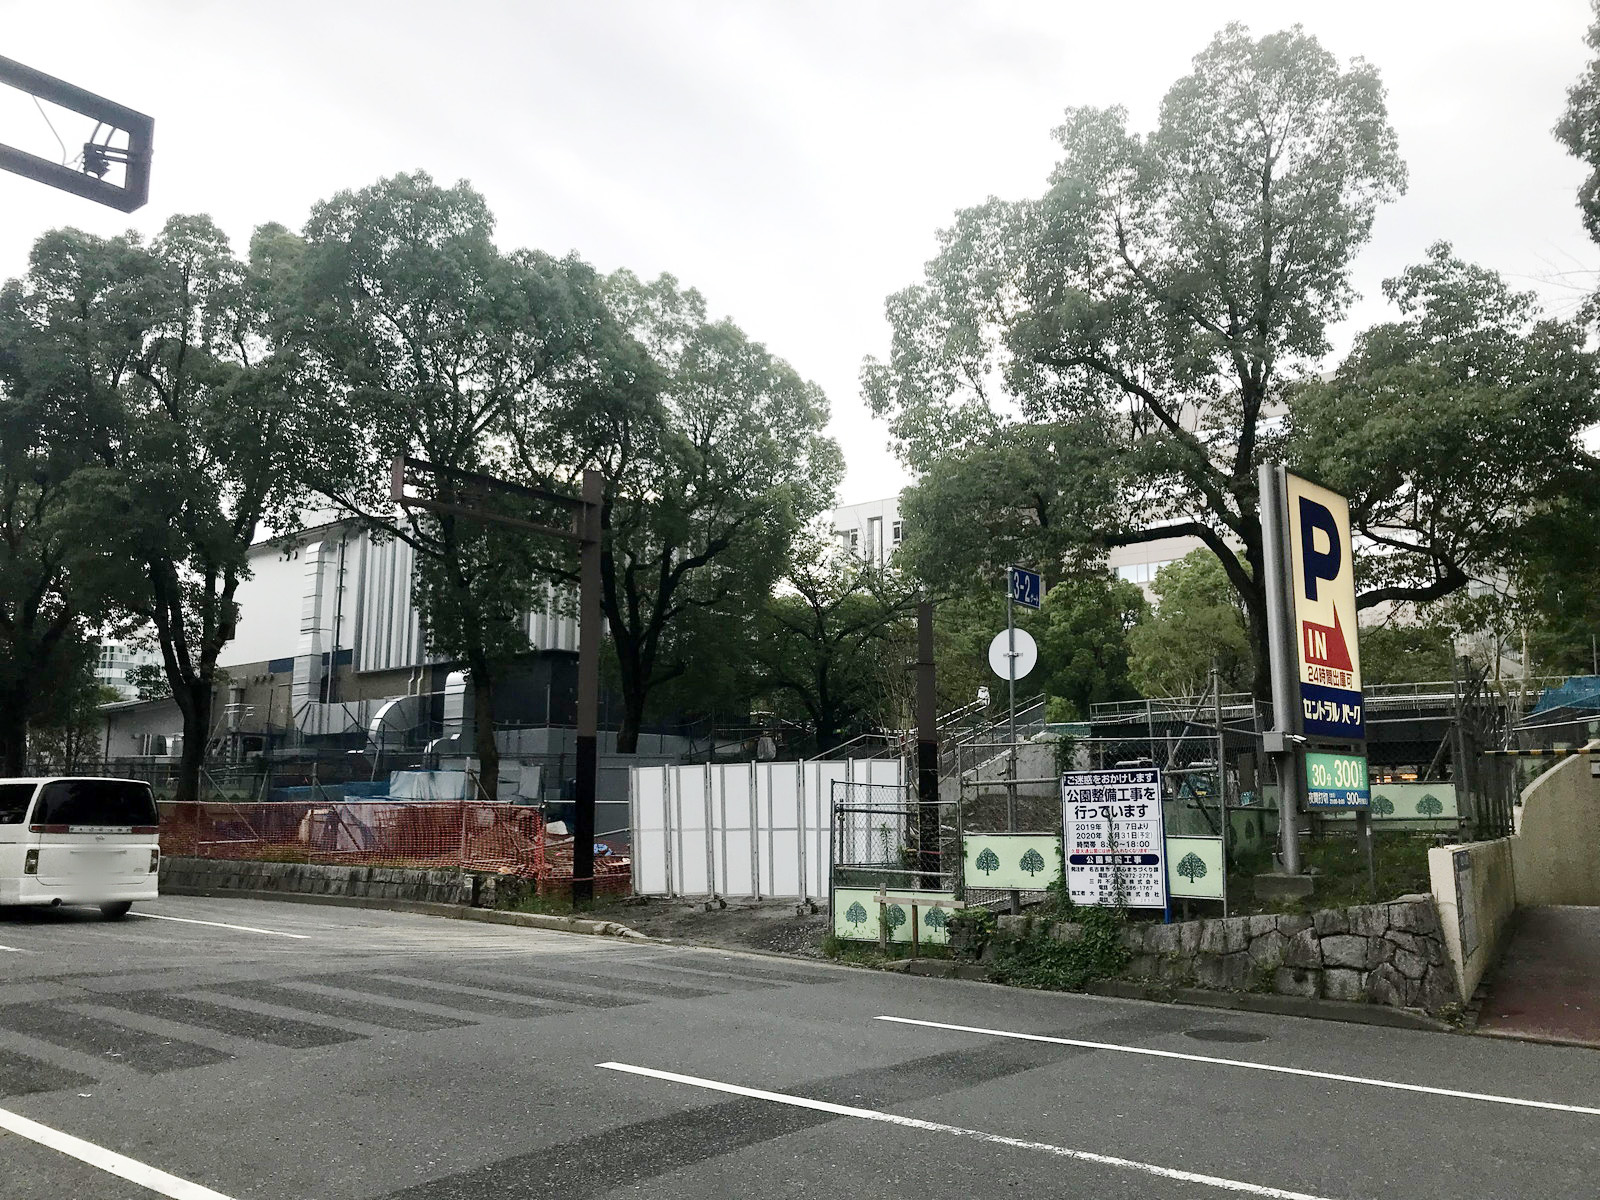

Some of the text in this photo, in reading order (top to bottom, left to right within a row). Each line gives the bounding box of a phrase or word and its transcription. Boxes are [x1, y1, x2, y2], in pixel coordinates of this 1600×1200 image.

[1299, 495, 1342, 602] P
[1307, 628, 1328, 661] IN
[1307, 665, 1353, 689] 24時間出庫可
[1066, 772, 1154, 785] ご迷惑をおかけします
[1311, 763, 1332, 787] 30分
[1334, 759, 1359, 788] 300
[1066, 787, 1156, 803] 公園整備工事を
[1074, 803, 1149, 820] 行っています
[1075, 823, 1102, 831] 2019年
[1076, 832, 1102, 840] 2020年
